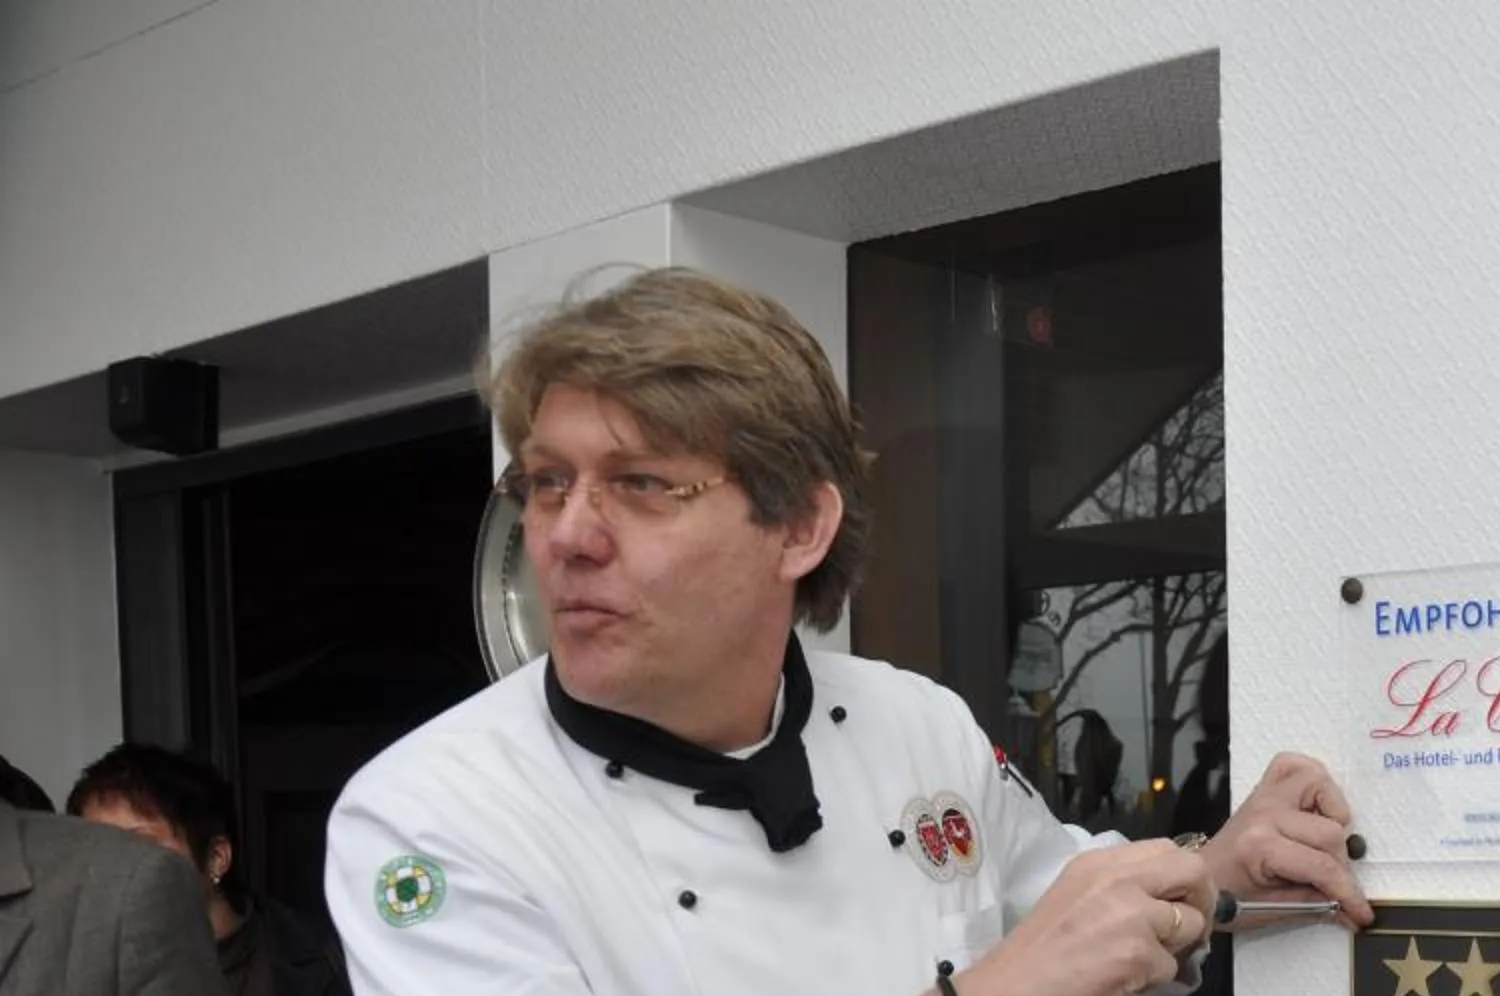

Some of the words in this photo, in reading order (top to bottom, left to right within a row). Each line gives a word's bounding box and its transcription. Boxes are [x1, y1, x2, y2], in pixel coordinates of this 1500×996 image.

[1370, 659, 1468, 739] La
[1383, 752, 1411, 769] Das
[1413, 750, 1458, 767] Hotel-
[1464, 748, 1493, 766] und
